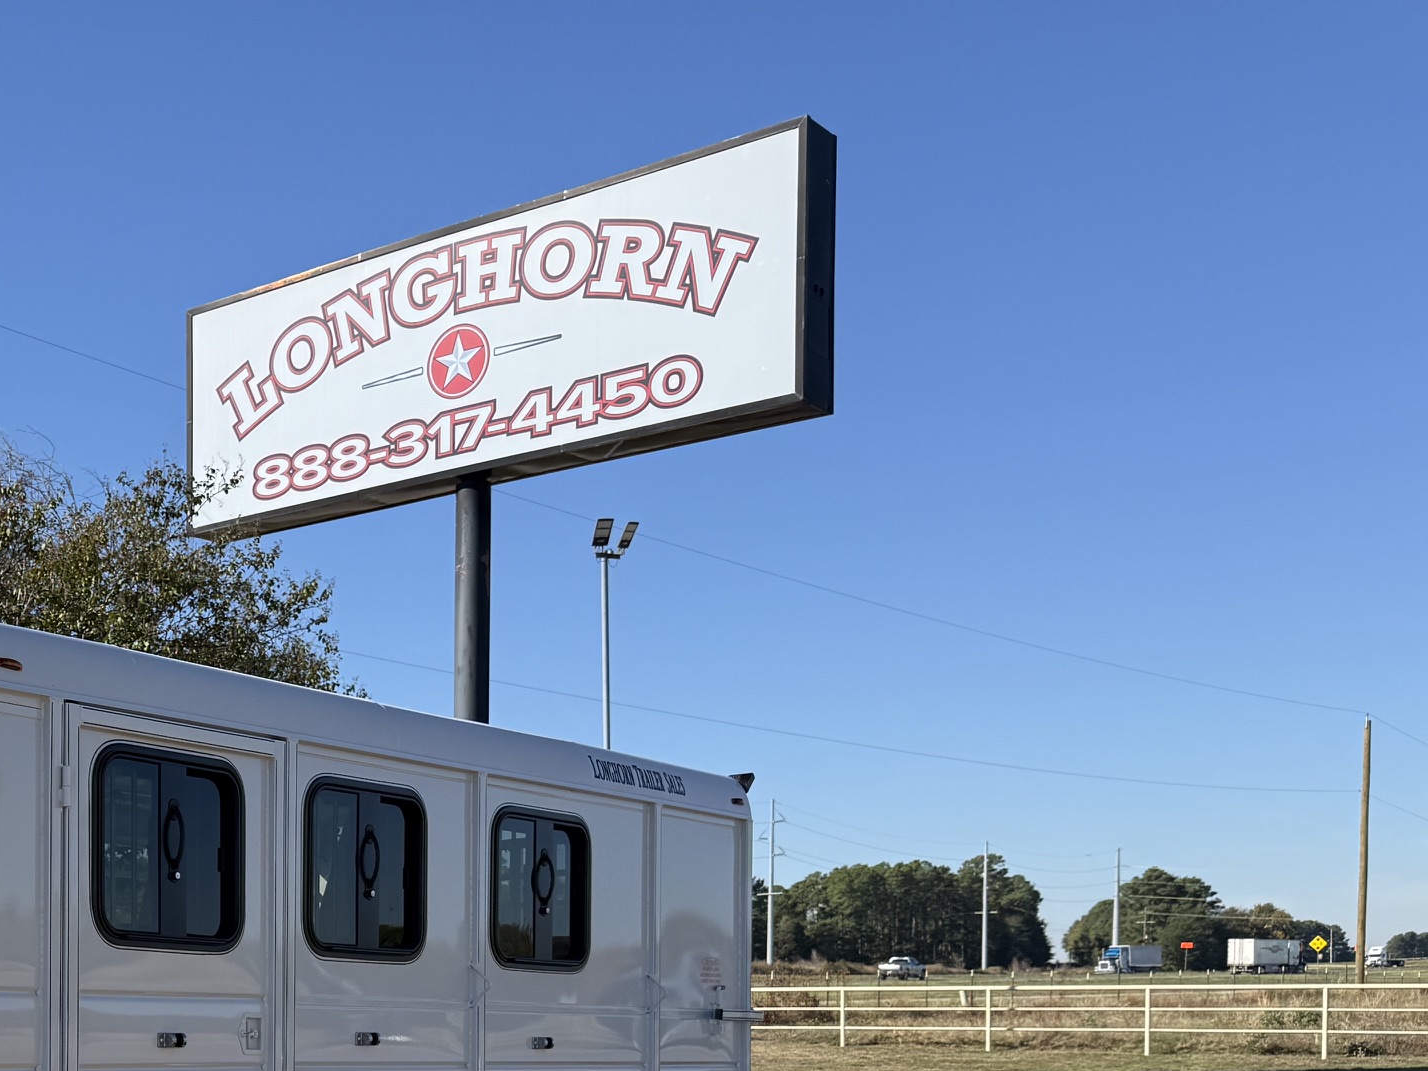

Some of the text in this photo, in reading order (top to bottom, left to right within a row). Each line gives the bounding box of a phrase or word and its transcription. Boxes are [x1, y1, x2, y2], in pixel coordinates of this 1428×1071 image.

[216, 219, 759, 440] LONGHORN
[253, 354, 703, 500] 888-317-4450
[587, 755, 686, 796] LONGHORN TRAILER SALES
